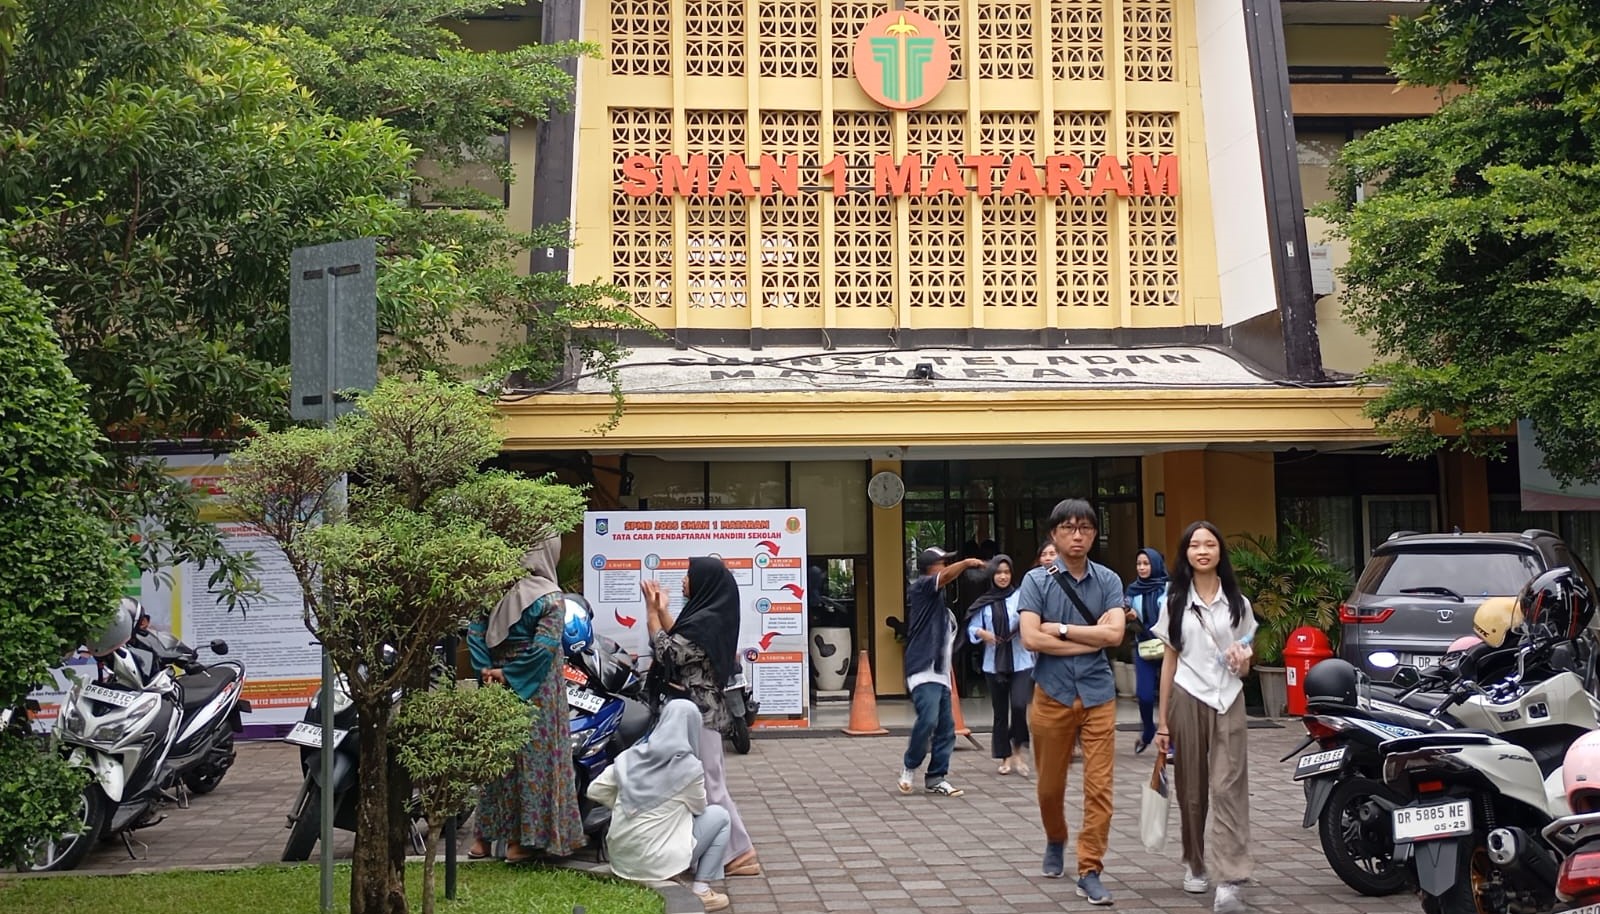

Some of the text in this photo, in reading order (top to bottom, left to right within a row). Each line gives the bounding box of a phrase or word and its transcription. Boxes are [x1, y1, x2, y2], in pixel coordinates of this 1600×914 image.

[622, 154, 1179, 198] SMAN 1 MATARAM
[920, 354, 1201, 366] TELADAN
[624, 521, 652, 531] SPMB
[681, 520, 710, 530] SMAN
[712, 520, 718, 529] 1
[721, 520, 770, 529] MATARAM
[612, 531, 782, 541] TATA CARA PENDAFTARAN MANDIRI SEKOLAH
[1418, 656, 1431, 668] DR
[85, 685, 97, 693] DR
[1397, 804, 1464, 824] DR 5885 NE
